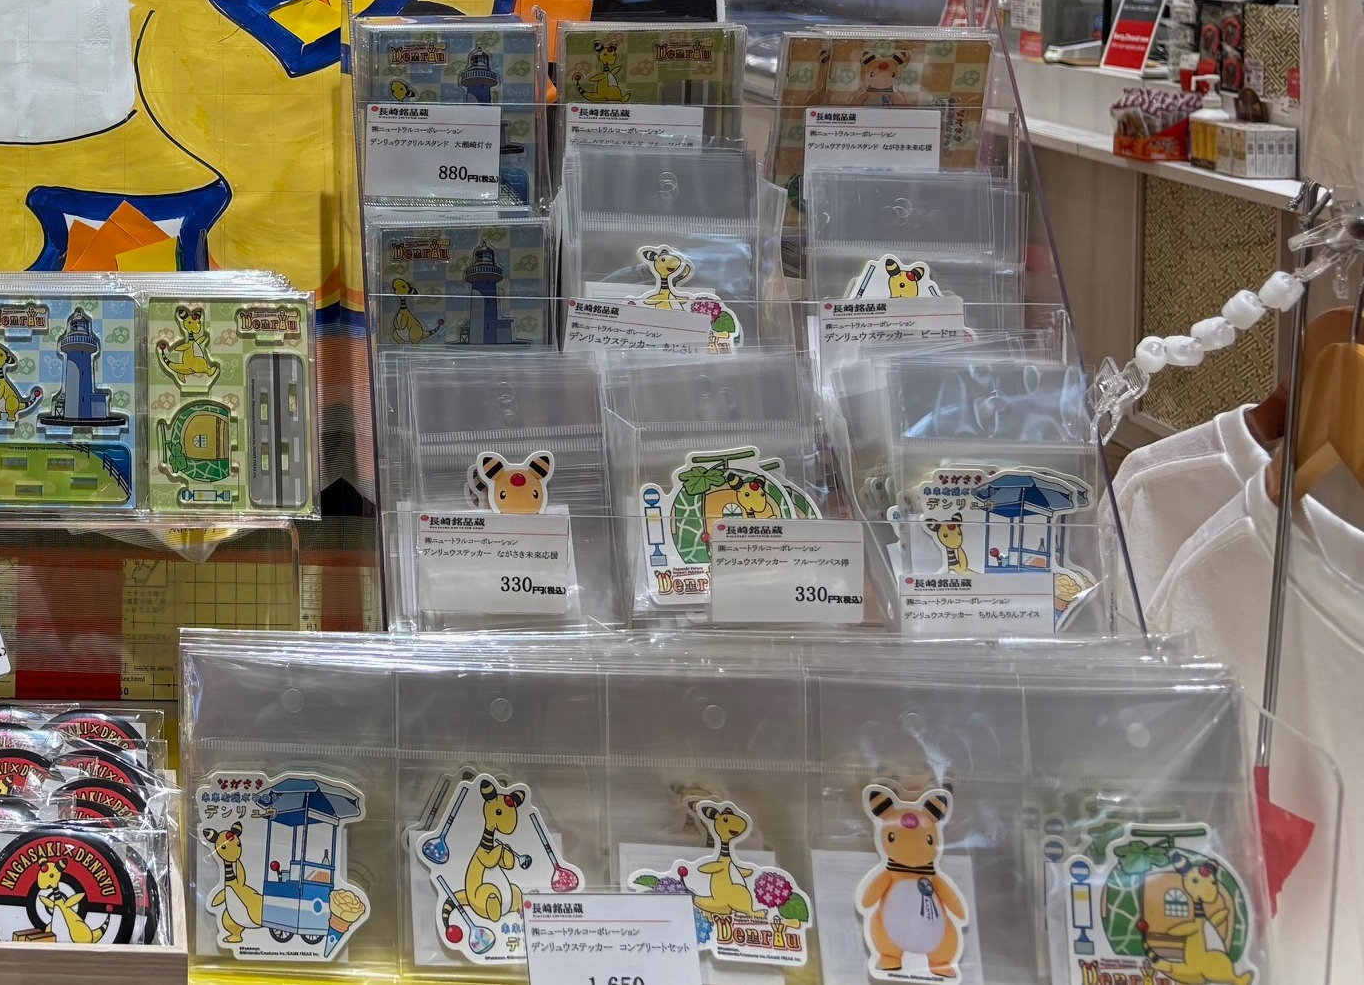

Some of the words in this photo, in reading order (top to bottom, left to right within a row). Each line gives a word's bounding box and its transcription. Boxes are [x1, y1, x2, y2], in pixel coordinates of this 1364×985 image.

[428, 516, 486, 527] 長崎銘品蔵
[725, 524, 784, 535] 長崎銘品蔵
[913, 577, 973, 589] 長崎銘品蔵
[532, 903, 584, 914] 長崎銘品蔵
